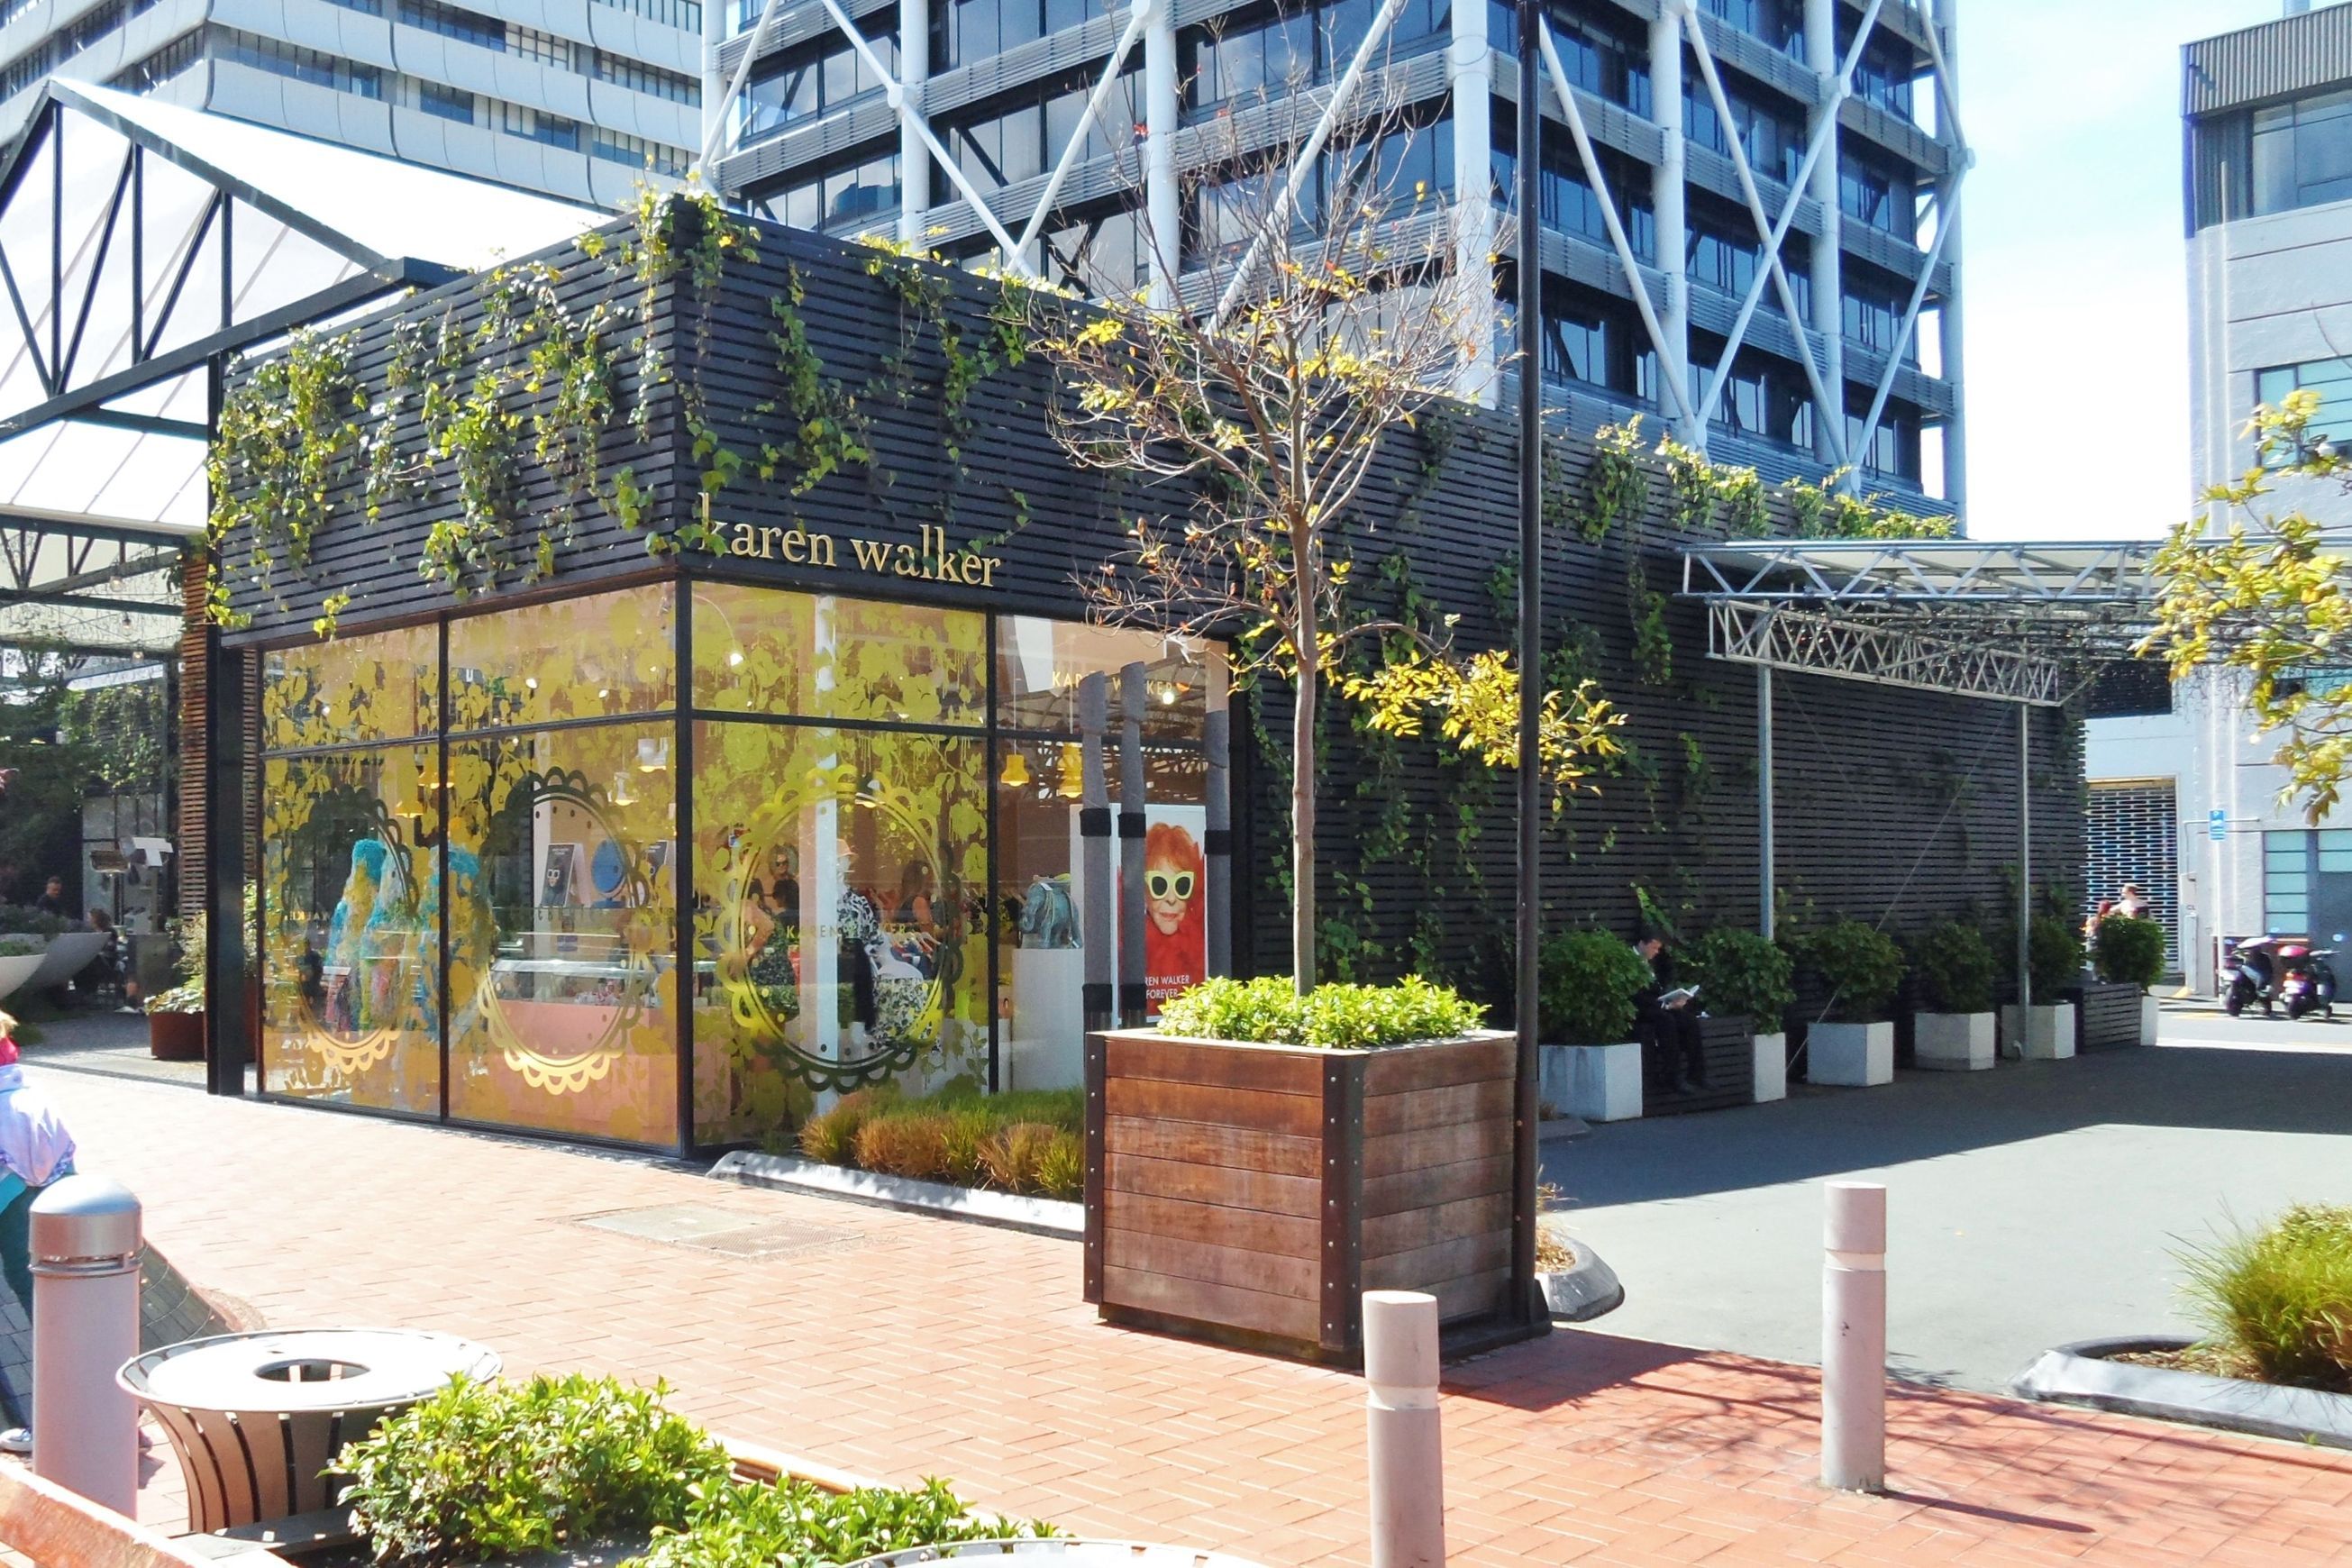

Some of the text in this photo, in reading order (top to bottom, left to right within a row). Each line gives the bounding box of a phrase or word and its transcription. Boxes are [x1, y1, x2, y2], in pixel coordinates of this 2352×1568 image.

[697, 491, 1001, 587] karen walker
[1112, 676, 1171, 696] WKER
[1161, 974, 1190, 985] WALKER
